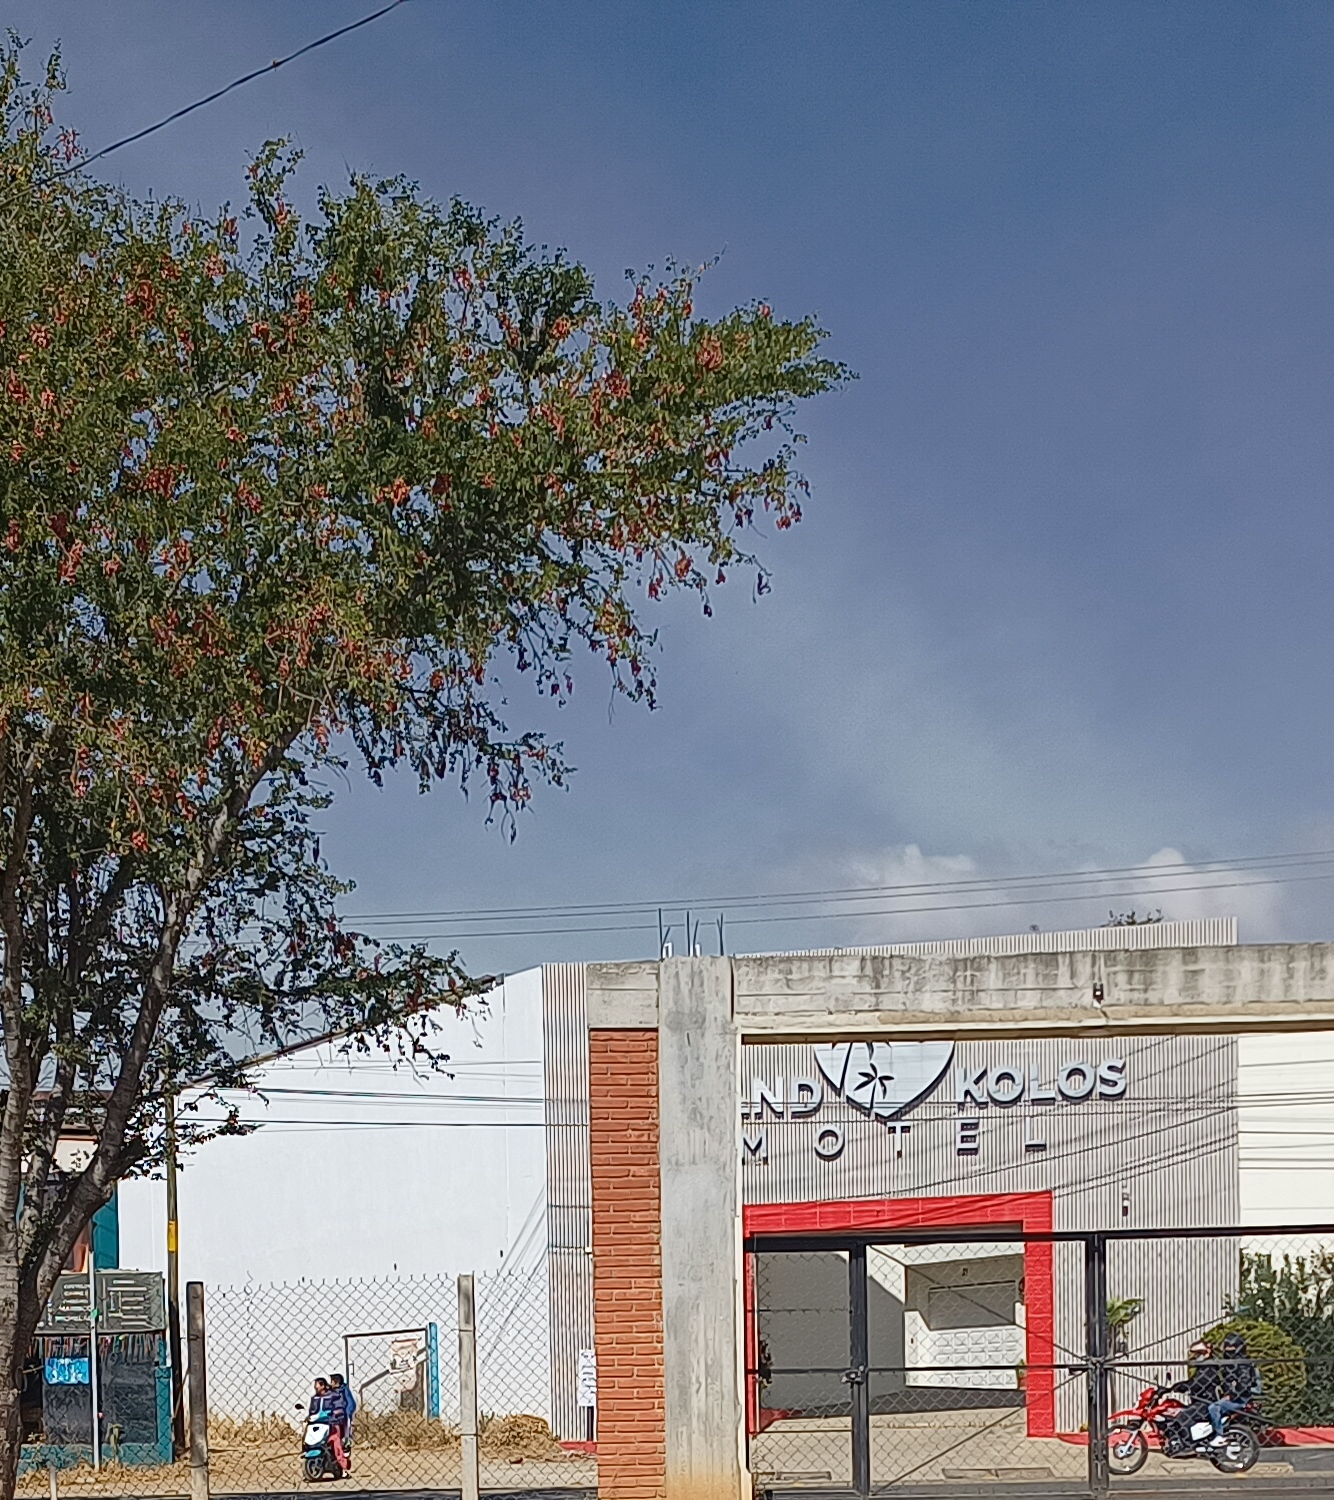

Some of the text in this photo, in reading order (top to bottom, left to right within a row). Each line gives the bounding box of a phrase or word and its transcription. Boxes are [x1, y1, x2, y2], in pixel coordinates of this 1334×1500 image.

[741, 1058, 1127, 1118] ND KOLOS
[741, 1120, 1047, 1164] MOTEL
